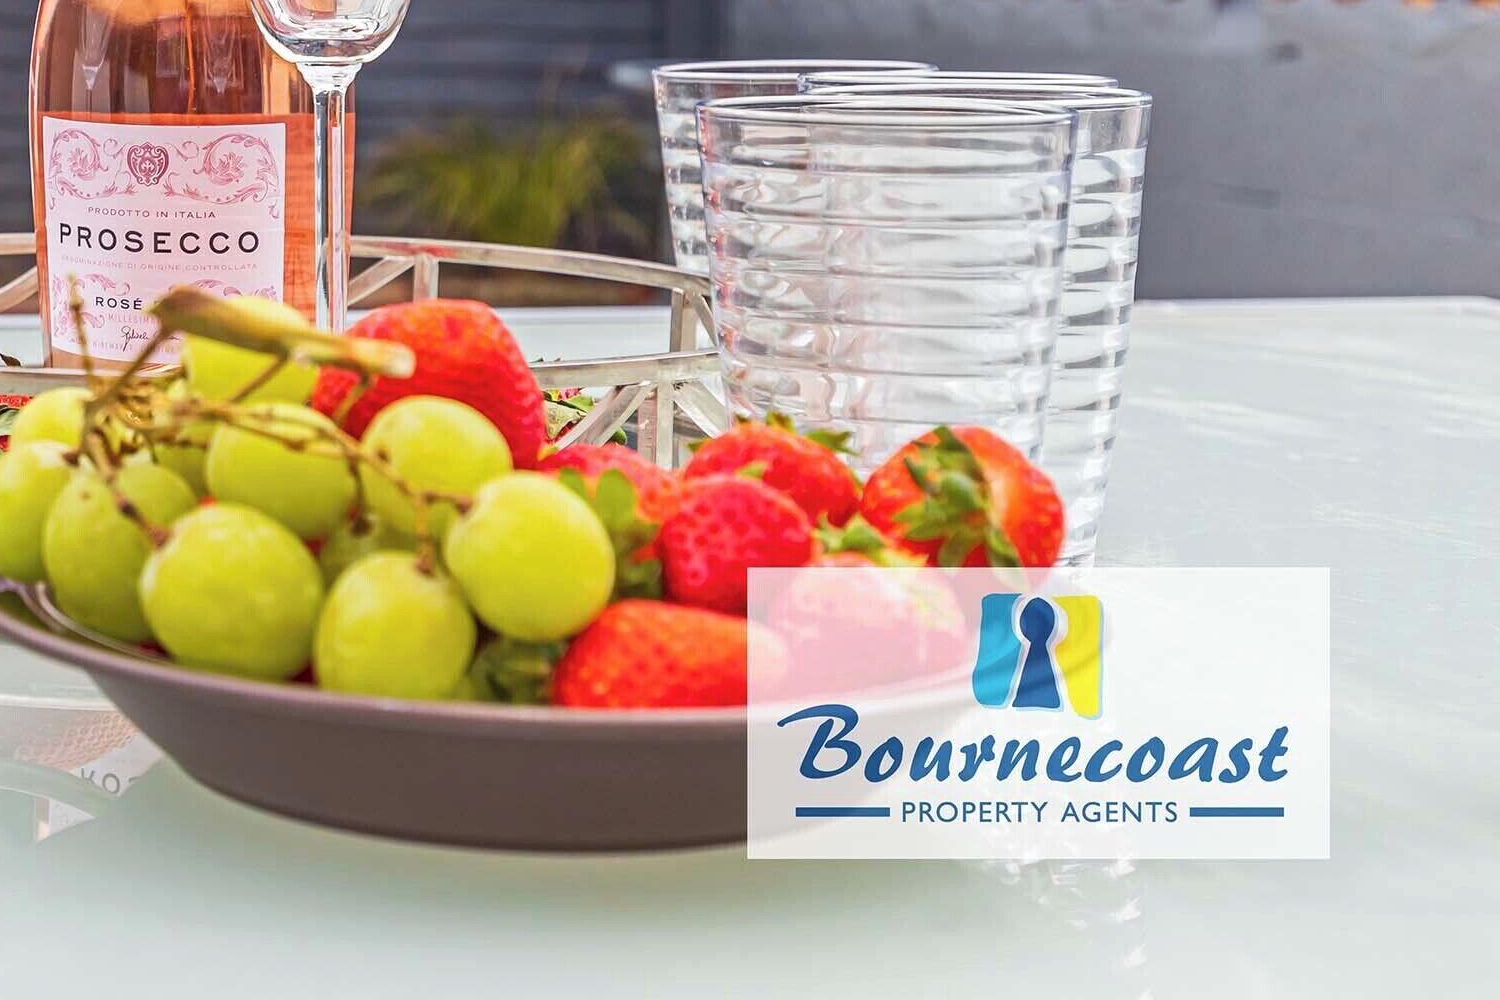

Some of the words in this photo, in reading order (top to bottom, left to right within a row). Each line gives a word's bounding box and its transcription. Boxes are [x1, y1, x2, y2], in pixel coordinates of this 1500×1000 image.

[88, 206, 150, 218] PRODOTTO
[174, 211, 216, 219] ITALIA
[60, 222, 259, 255] PROSECCO
[140, 263, 180, 271] ORIGINE
[185, 263, 258, 271] CONTROLLATA
[95, 296, 143, 310] ROSÉ
